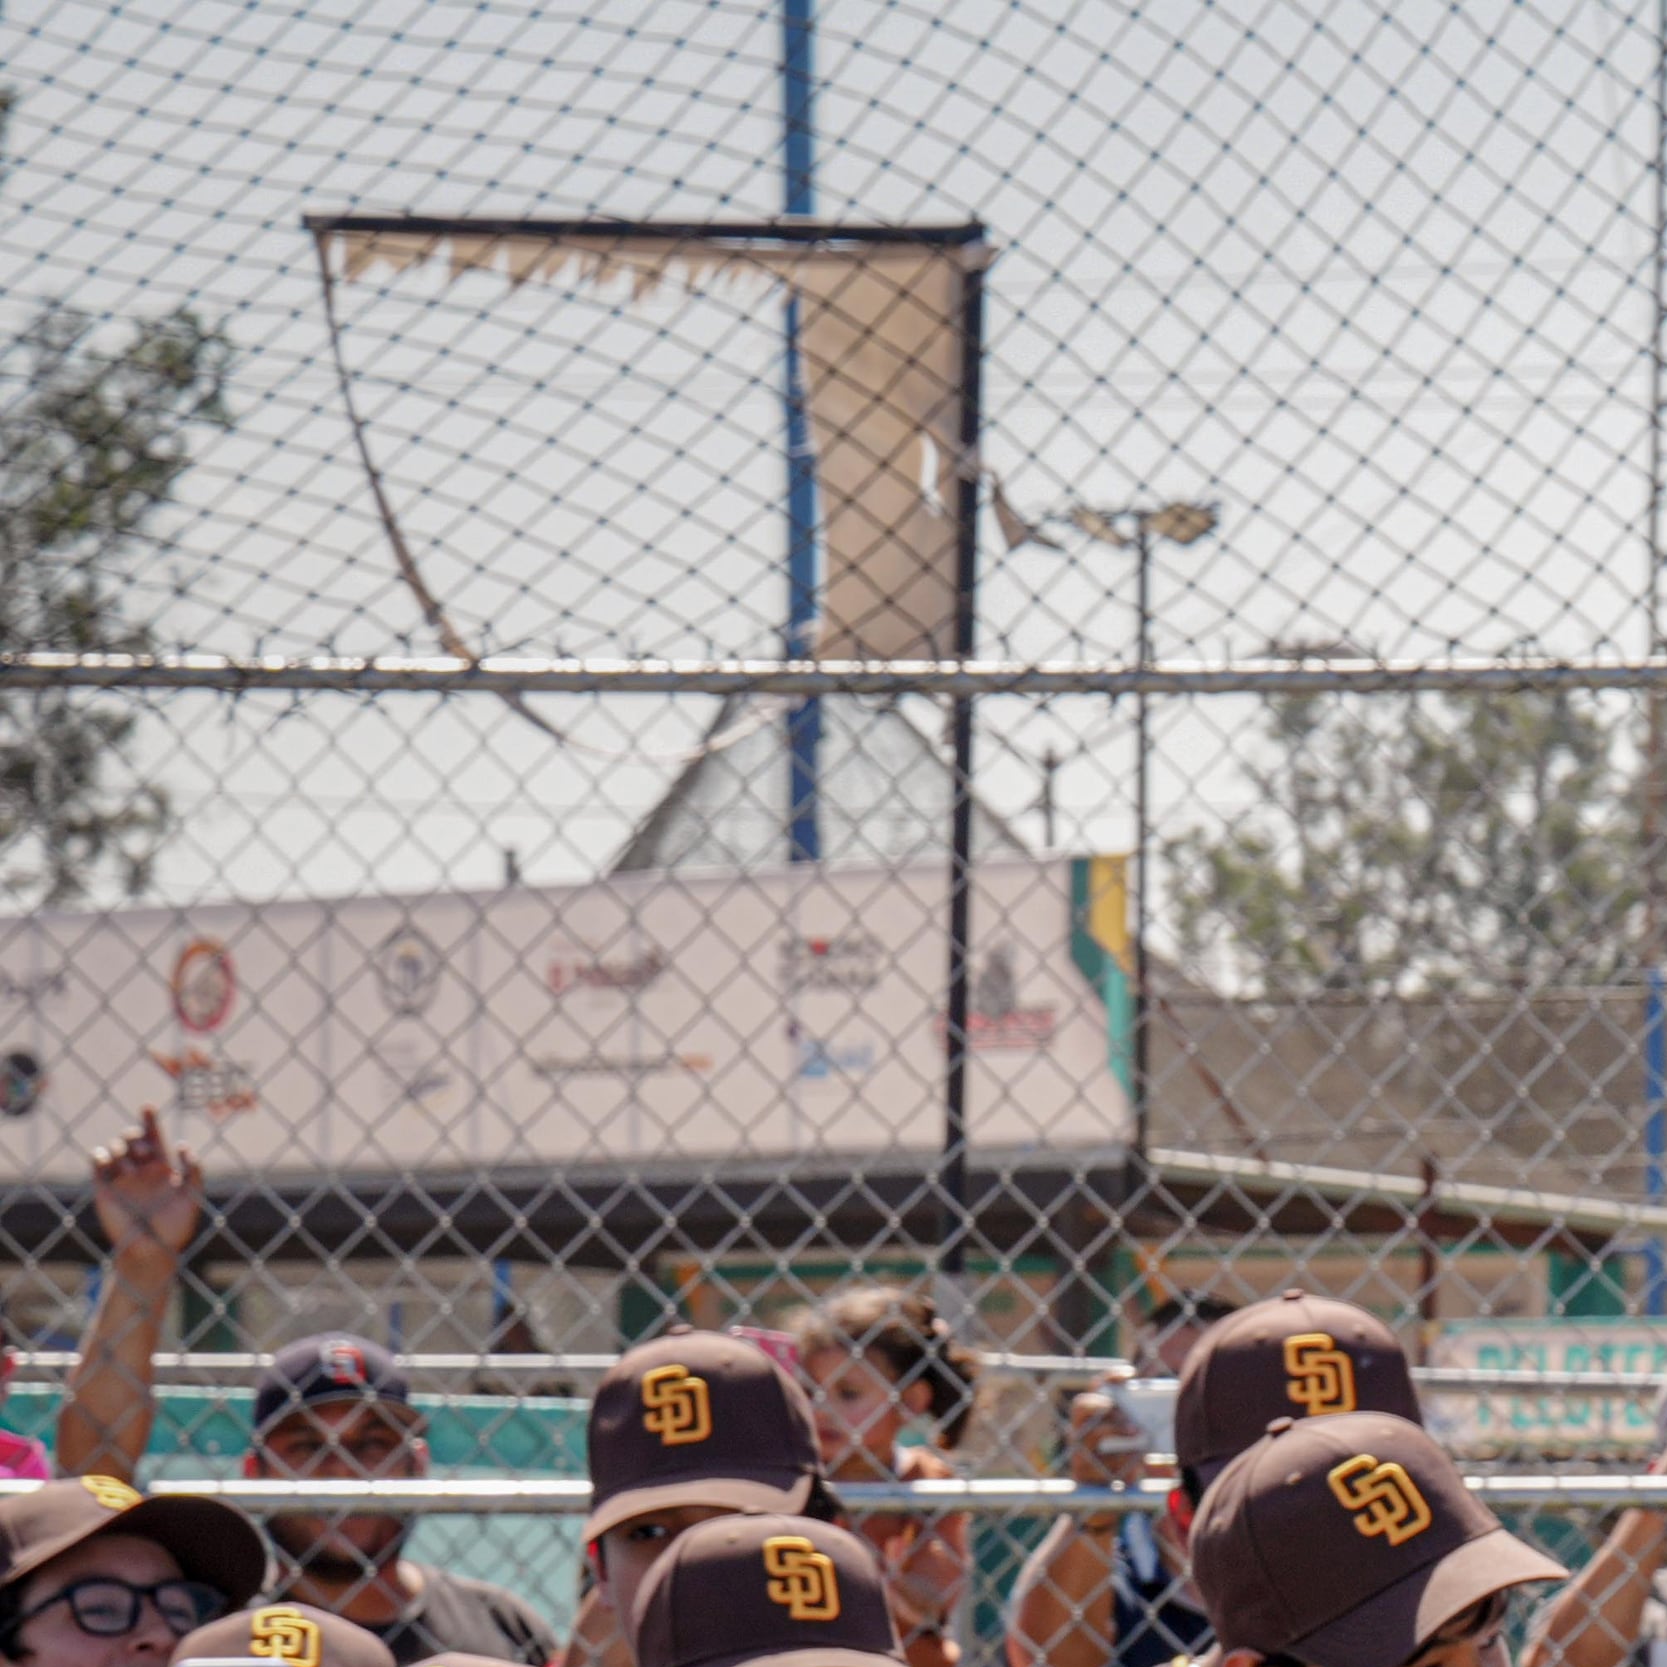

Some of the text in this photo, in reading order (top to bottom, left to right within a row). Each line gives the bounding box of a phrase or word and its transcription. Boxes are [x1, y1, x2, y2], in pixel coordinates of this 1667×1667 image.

[643, 1366, 713, 1446] SD
[1284, 1333, 1356, 1415] SD
[1328, 1453, 1432, 1546] SD
[763, 1536, 841, 1621] SD
